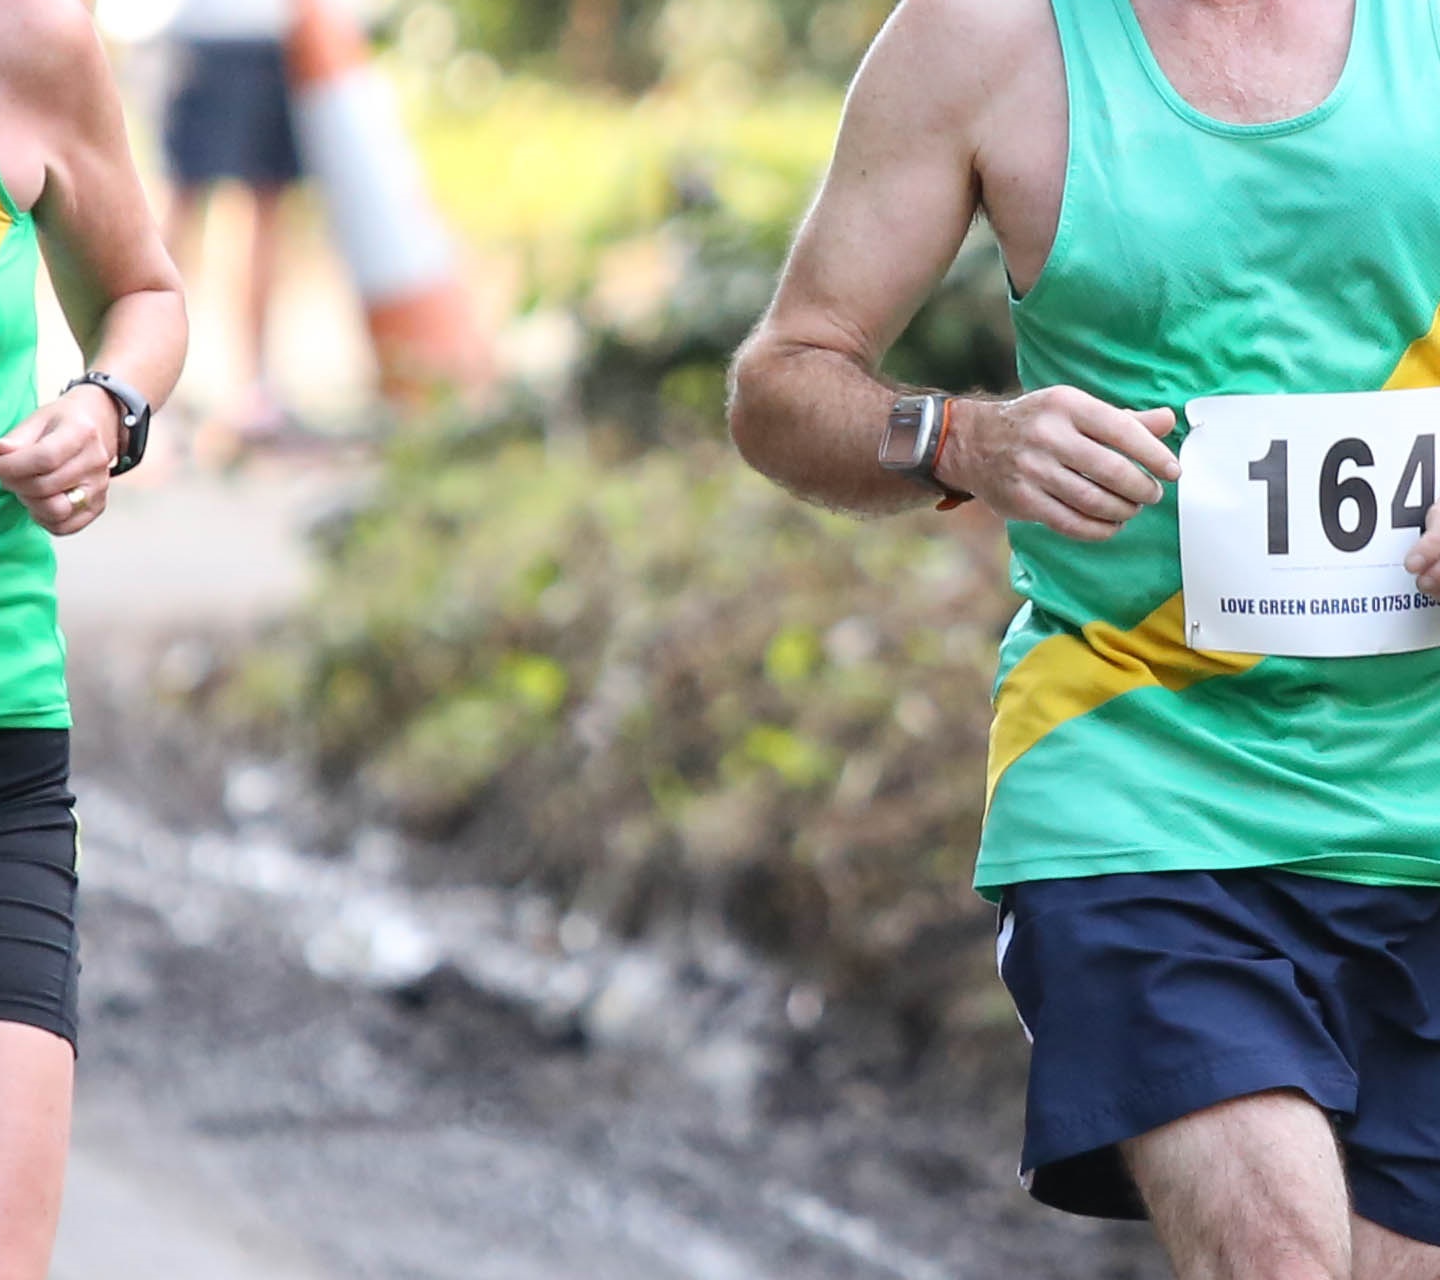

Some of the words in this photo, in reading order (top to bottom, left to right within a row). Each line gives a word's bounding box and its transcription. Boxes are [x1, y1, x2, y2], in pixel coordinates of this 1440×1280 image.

[1248, 433, 1436, 556] 164
[1220, 597, 1255, 614] LOVE
[1259, 598, 1306, 615] GREEN
[1309, 597, 1368, 615] GARAGE
[1372, 594, 1411, 612] 01753
